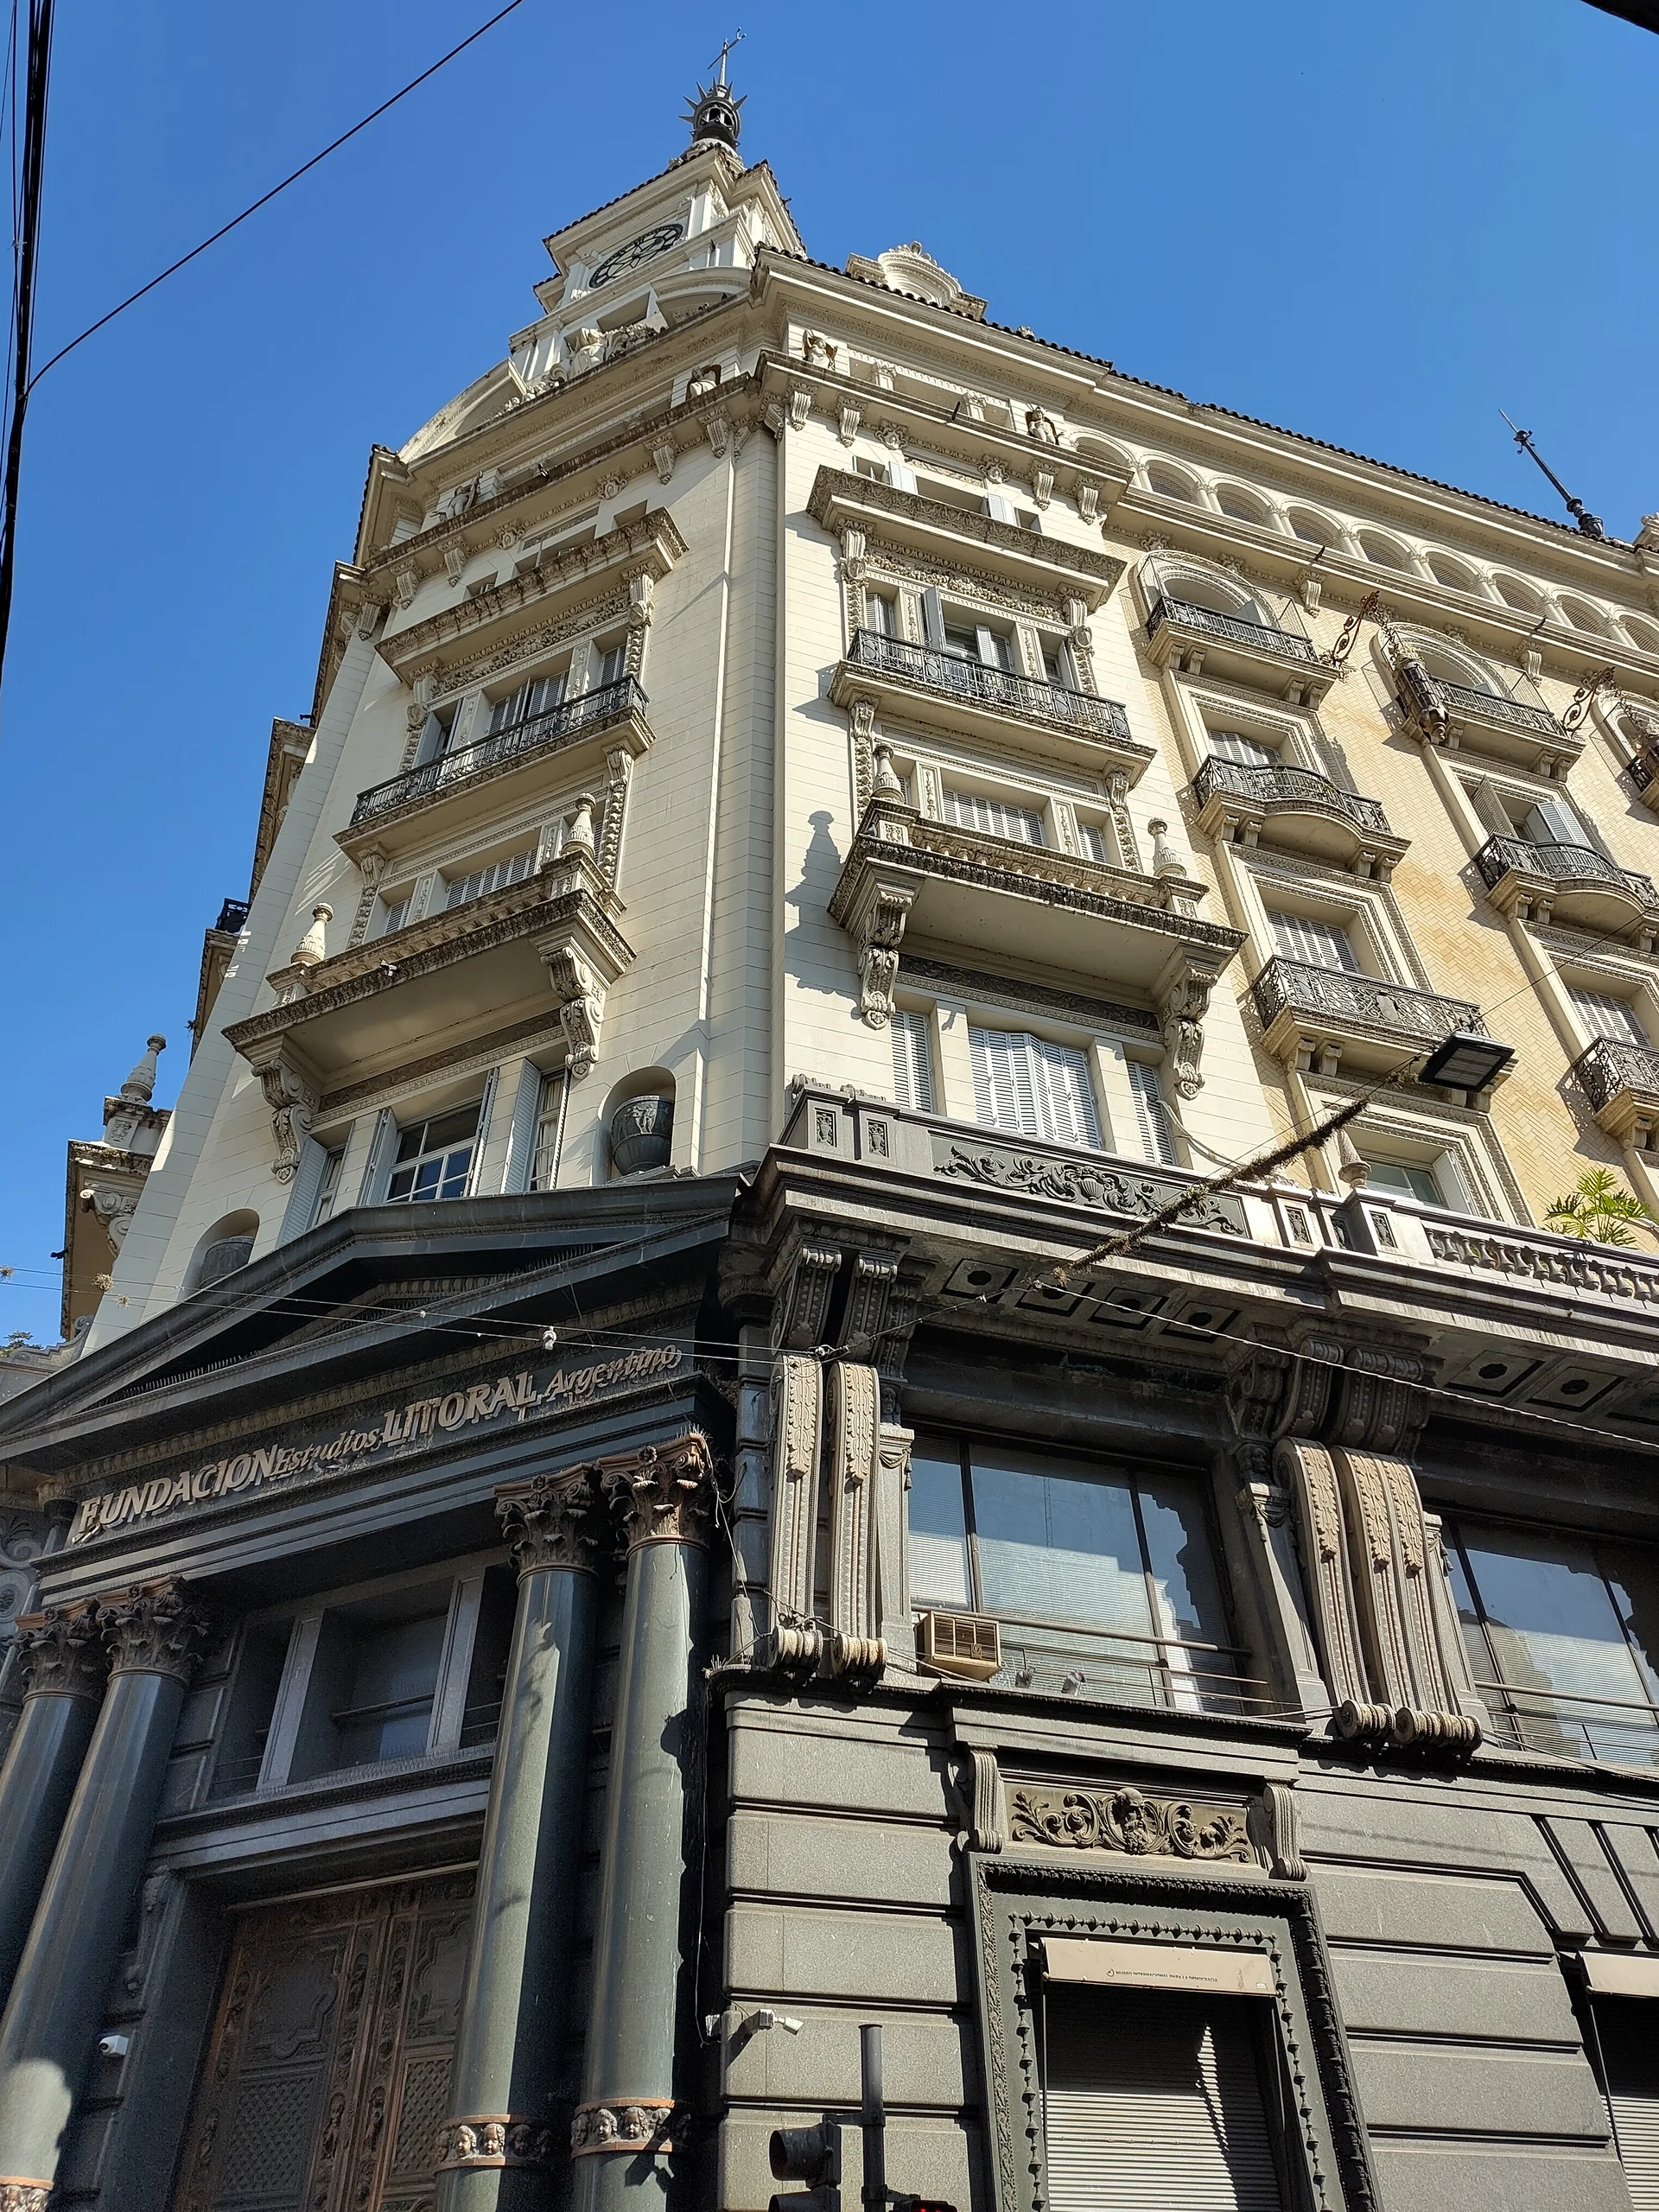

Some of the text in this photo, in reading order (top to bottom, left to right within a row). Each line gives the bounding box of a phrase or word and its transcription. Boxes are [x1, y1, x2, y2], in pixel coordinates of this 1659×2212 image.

[77, 1344, 678, 1534] FUNDACION Estudios LITORAL Argentino
